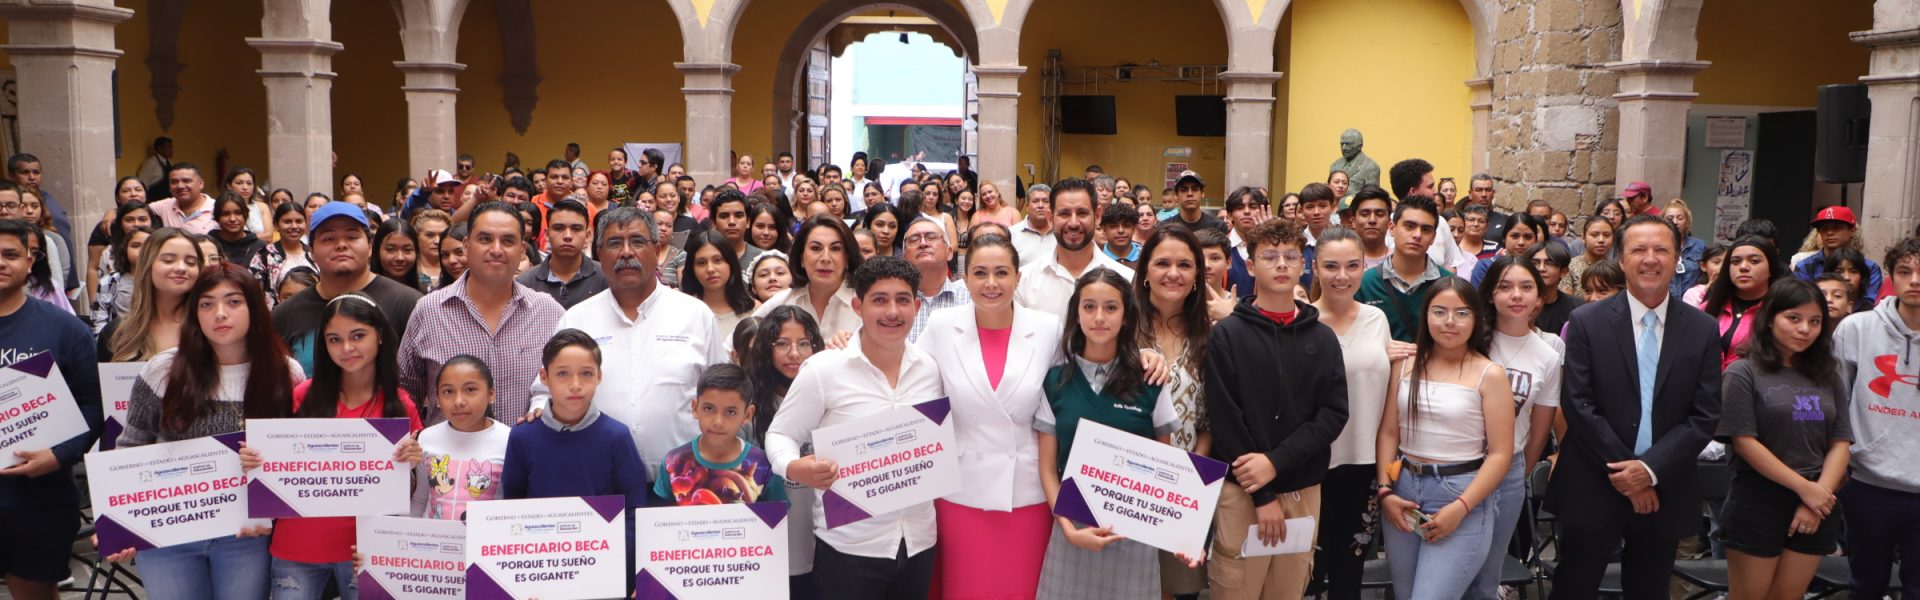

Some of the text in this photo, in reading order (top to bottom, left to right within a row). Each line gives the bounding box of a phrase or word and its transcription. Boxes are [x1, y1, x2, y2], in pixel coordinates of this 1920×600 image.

[22, 393, 56, 412] BECA
[1868, 403, 1905, 416] UNDER
[1, 411, 48, 435] TU SUEÑO
[263, 460, 394, 472] BENEFICIARIO BECA
[836, 450, 911, 480] ENEFICIARIO
[914, 442, 943, 460] BECA
[279, 474, 380, 486] “PORQUE TU SUEÑO
[848, 460, 933, 489] “PORQUE TU SUEÑO
[109, 476, 248, 507] BENEFICIARIO BECA
[298, 489, 363, 498] ES GIGANTE”
[866, 476, 921, 498] ES GIGANTE”
[1080, 464, 1199, 511] BENEFICIARIO BECA
[128, 493, 237, 518] “PORQUE TU SUEÑO
[1091, 484, 1182, 520] “PORQUE TU SUEÑO
[151, 509, 220, 528] ES GIGANTE”
[1104, 502, 1164, 526] ES GIGANTE”
[481, 540, 609, 556] BENEFICIARIO BECA
[650, 546, 773, 562] BENEFICIARIO BECA
[371, 556, 454, 571] BENEFICIARIO
[497, 556, 596, 570] “PORQUE TU SUEÑO
[665, 560, 760, 575] “PORQUE TU SUEÑO
[386, 572, 429, 582] “PORQUE
[431, 574, 442, 583] TU
[515, 571, 579, 582] ES GIGANTE”
[683, 576, 744, 588] ES GIGANTE”
[402, 584, 461, 596] ES GIGANTE”
